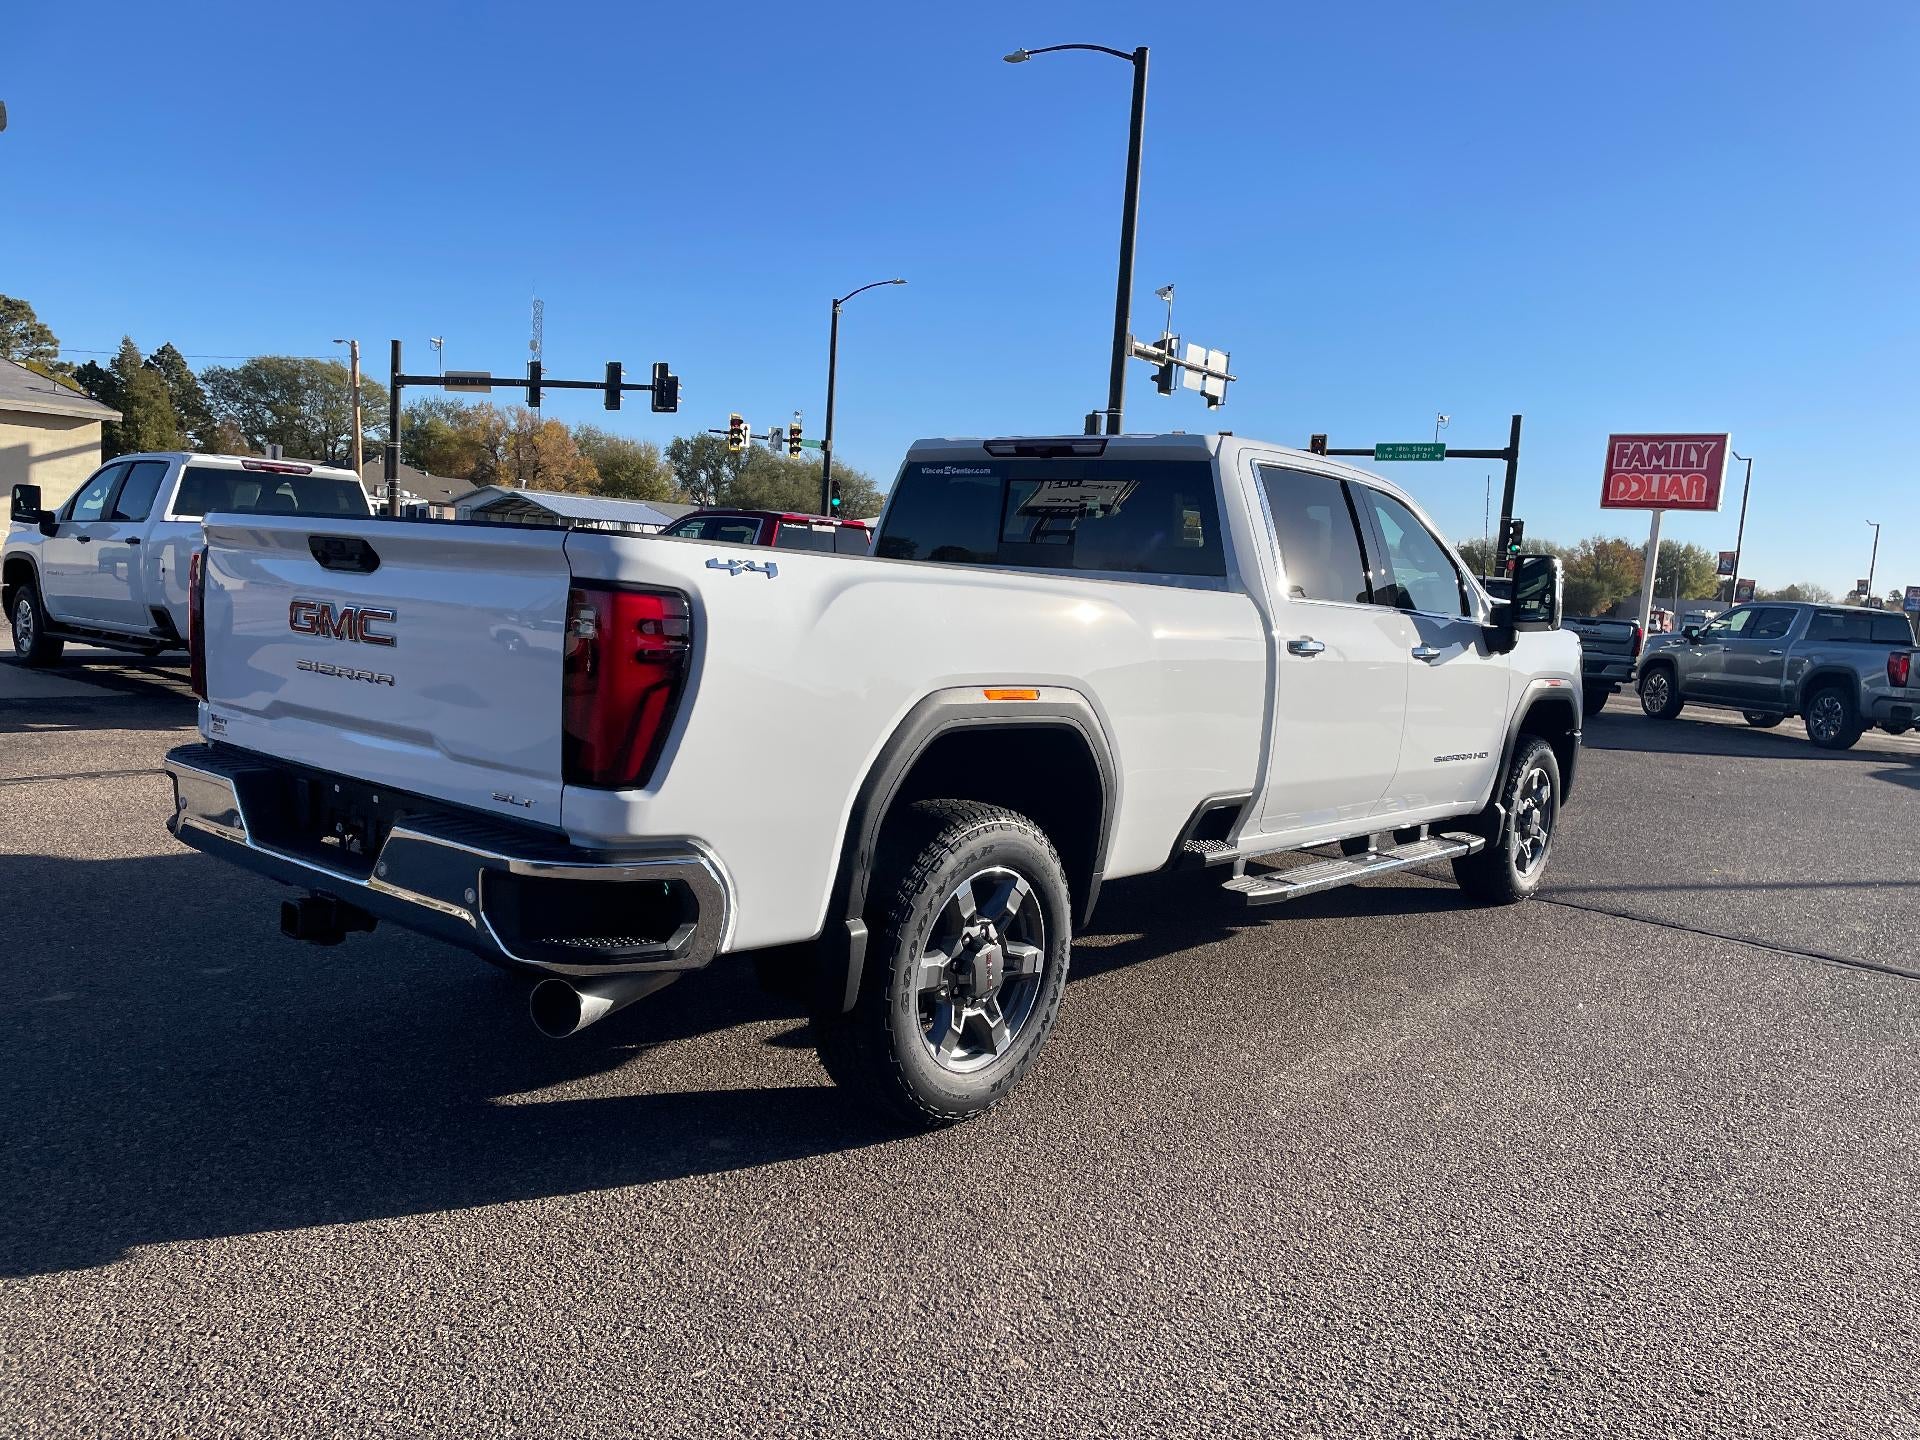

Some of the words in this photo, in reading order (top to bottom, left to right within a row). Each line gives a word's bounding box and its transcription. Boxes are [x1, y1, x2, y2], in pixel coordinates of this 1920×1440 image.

[1612, 442, 1717, 470] FAMILY
[1609, 473, 1707, 502] DOLLAR
[288, 597, 398, 648] GMC
[296, 659, 396, 687] SIERRA
[1433, 753, 1473, 763] SIERRA
[1473, 751, 1489, 760] HD
[491, 792, 537, 808] SLT
